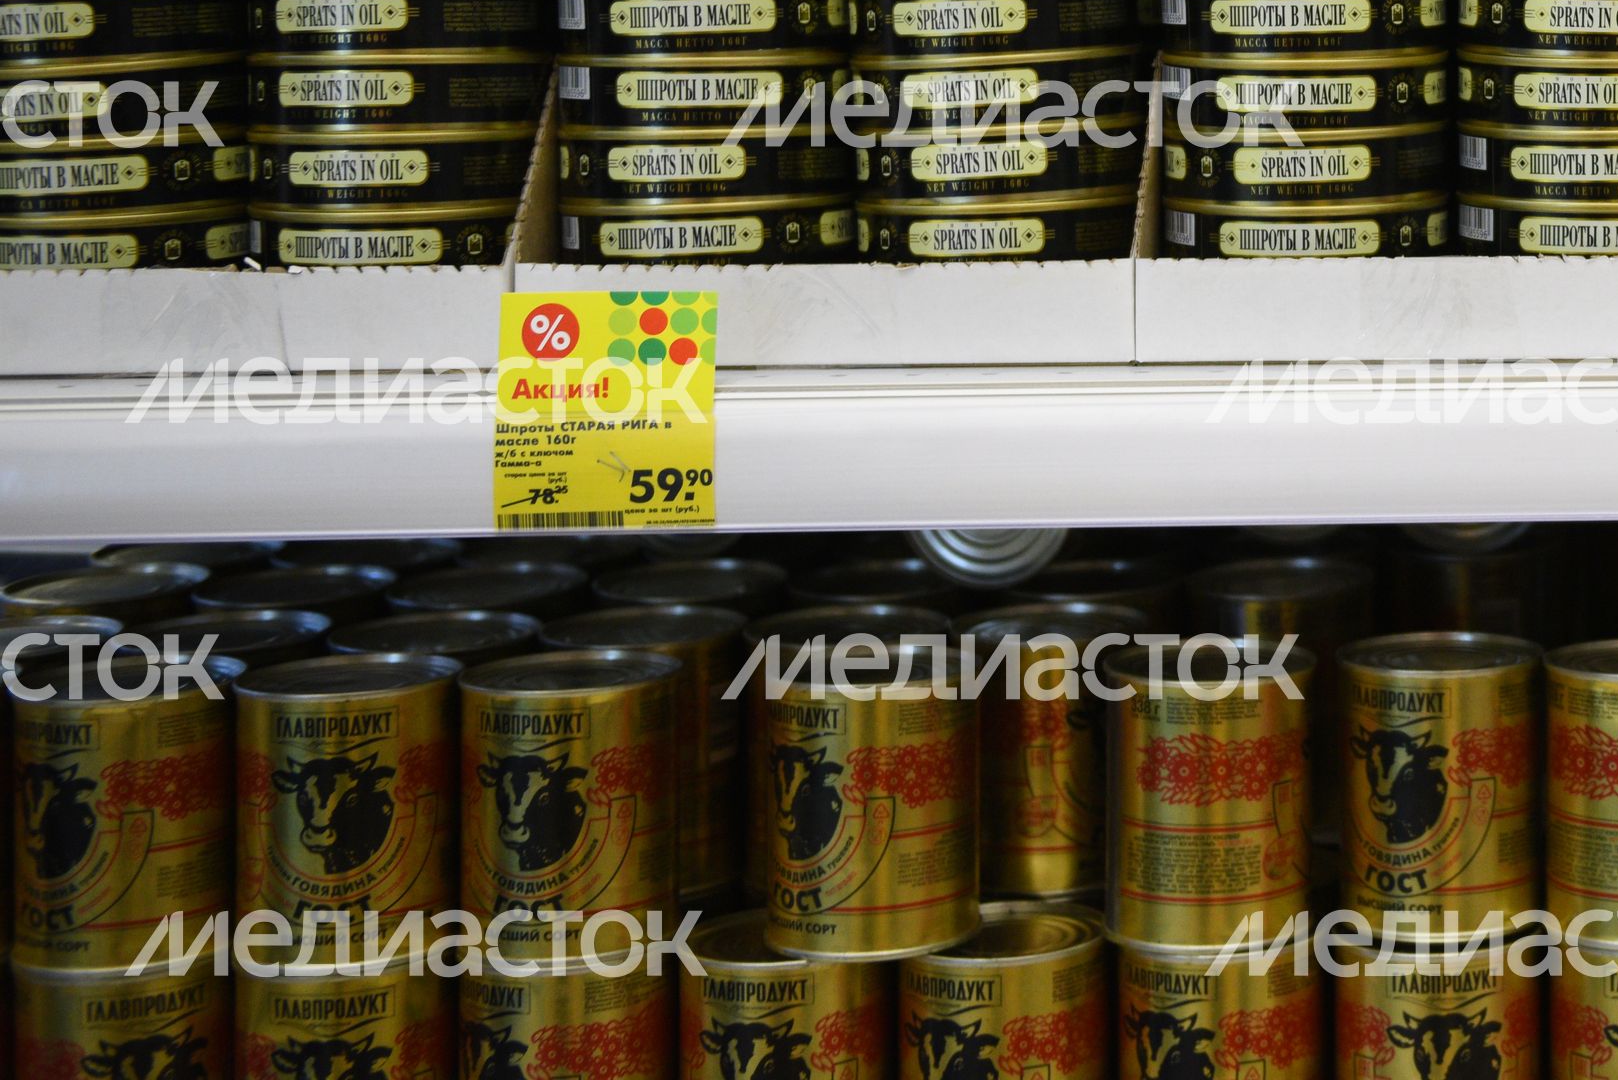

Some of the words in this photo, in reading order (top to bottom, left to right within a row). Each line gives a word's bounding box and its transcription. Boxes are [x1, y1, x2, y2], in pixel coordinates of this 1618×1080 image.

[629, 5, 689, 29] ШПРОТЫ
[694, 5, 702, 27] В
[706, 3, 751, 26] МАСЛЕ
[1529, 154, 1587, 176] ШПРОТЫ
[1592, 154, 1600, 176] В
[511, 377, 609, 402] Акция!
[496, 423, 555, 436] Шпроты
[560, 421, 615, 432] СТАРАЯ
[621, 420, 658, 430] РИГА
[495, 438, 539, 447] масле
[546, 435, 576, 445] 160г
[530, 449, 574, 457] ключом
[1365, 865, 1428, 894] ГОСТ
